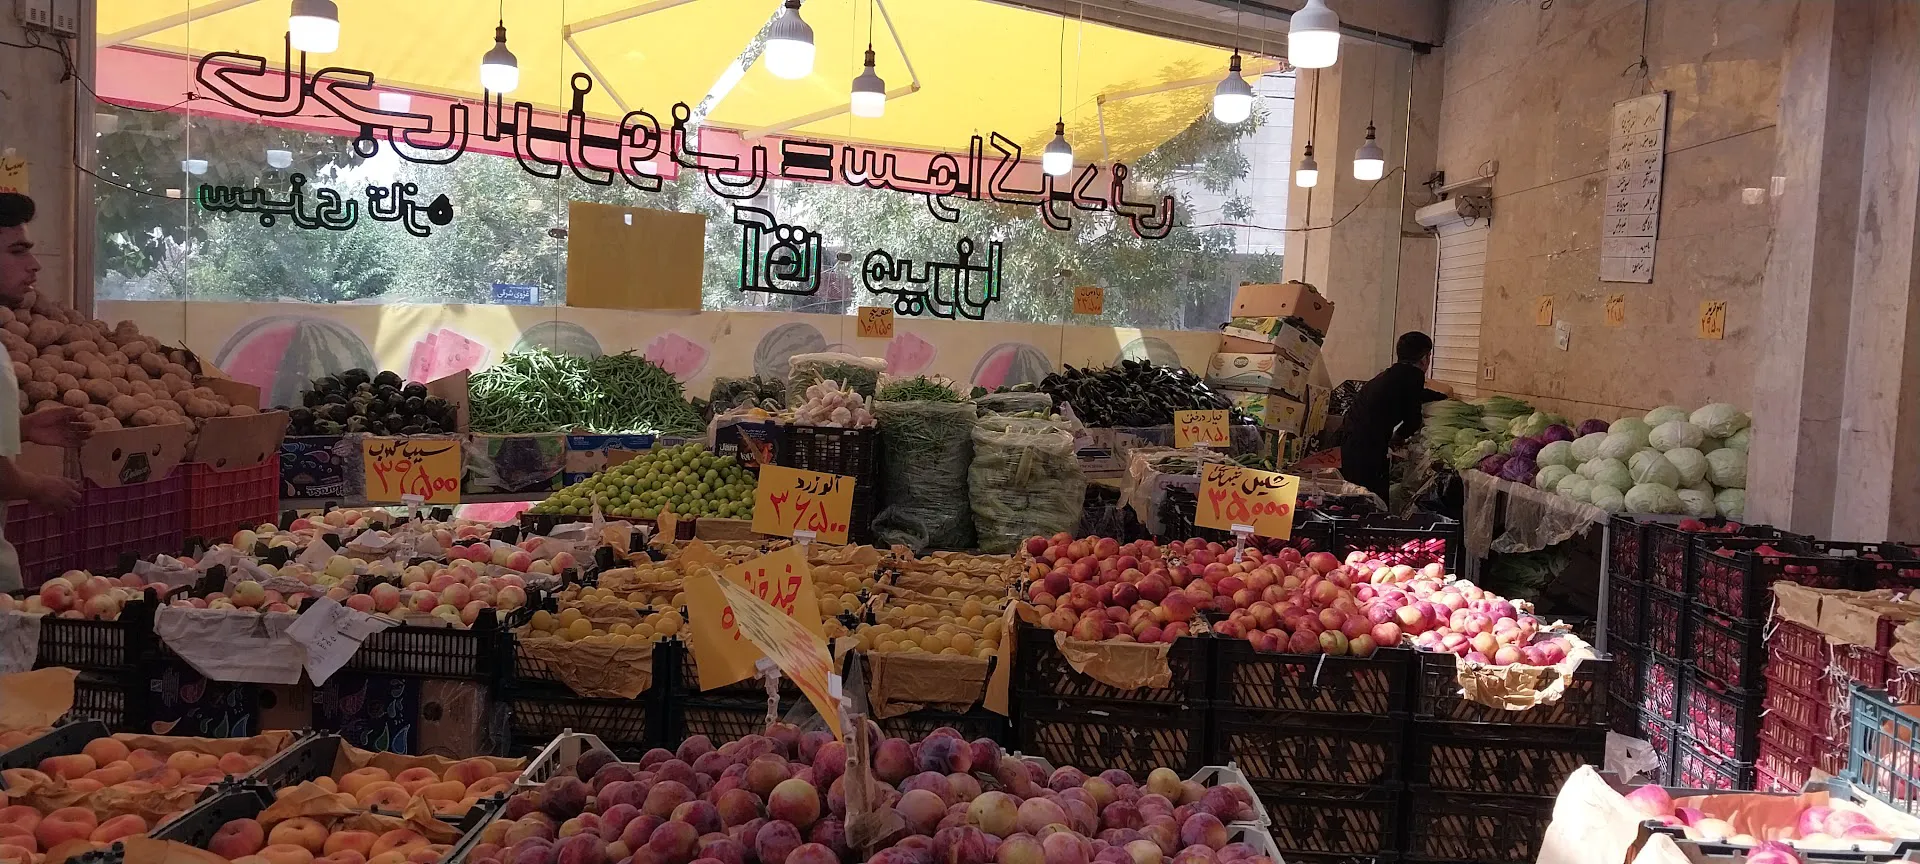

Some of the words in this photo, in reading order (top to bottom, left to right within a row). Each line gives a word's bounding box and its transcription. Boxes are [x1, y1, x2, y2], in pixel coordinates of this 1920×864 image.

[497, 289, 513, 299] شرقی
[1181, 412, 1205, 424] درختی
[1208, 410, 1222, 424] خیار
[1181, 425, 1228, 442] ۲۹۸۵۰
[368, 441, 407, 462] گلاب
[402, 444, 455, 464] سیب
[373, 459, 458, 500] ۳۹۵۰۰
[795, 476, 820, 494] زرد
[818, 475, 842, 495] آلو
[1241, 475, 1290, 496] شلیل
[770, 489, 847, 533] ۳۶۵۰۰
